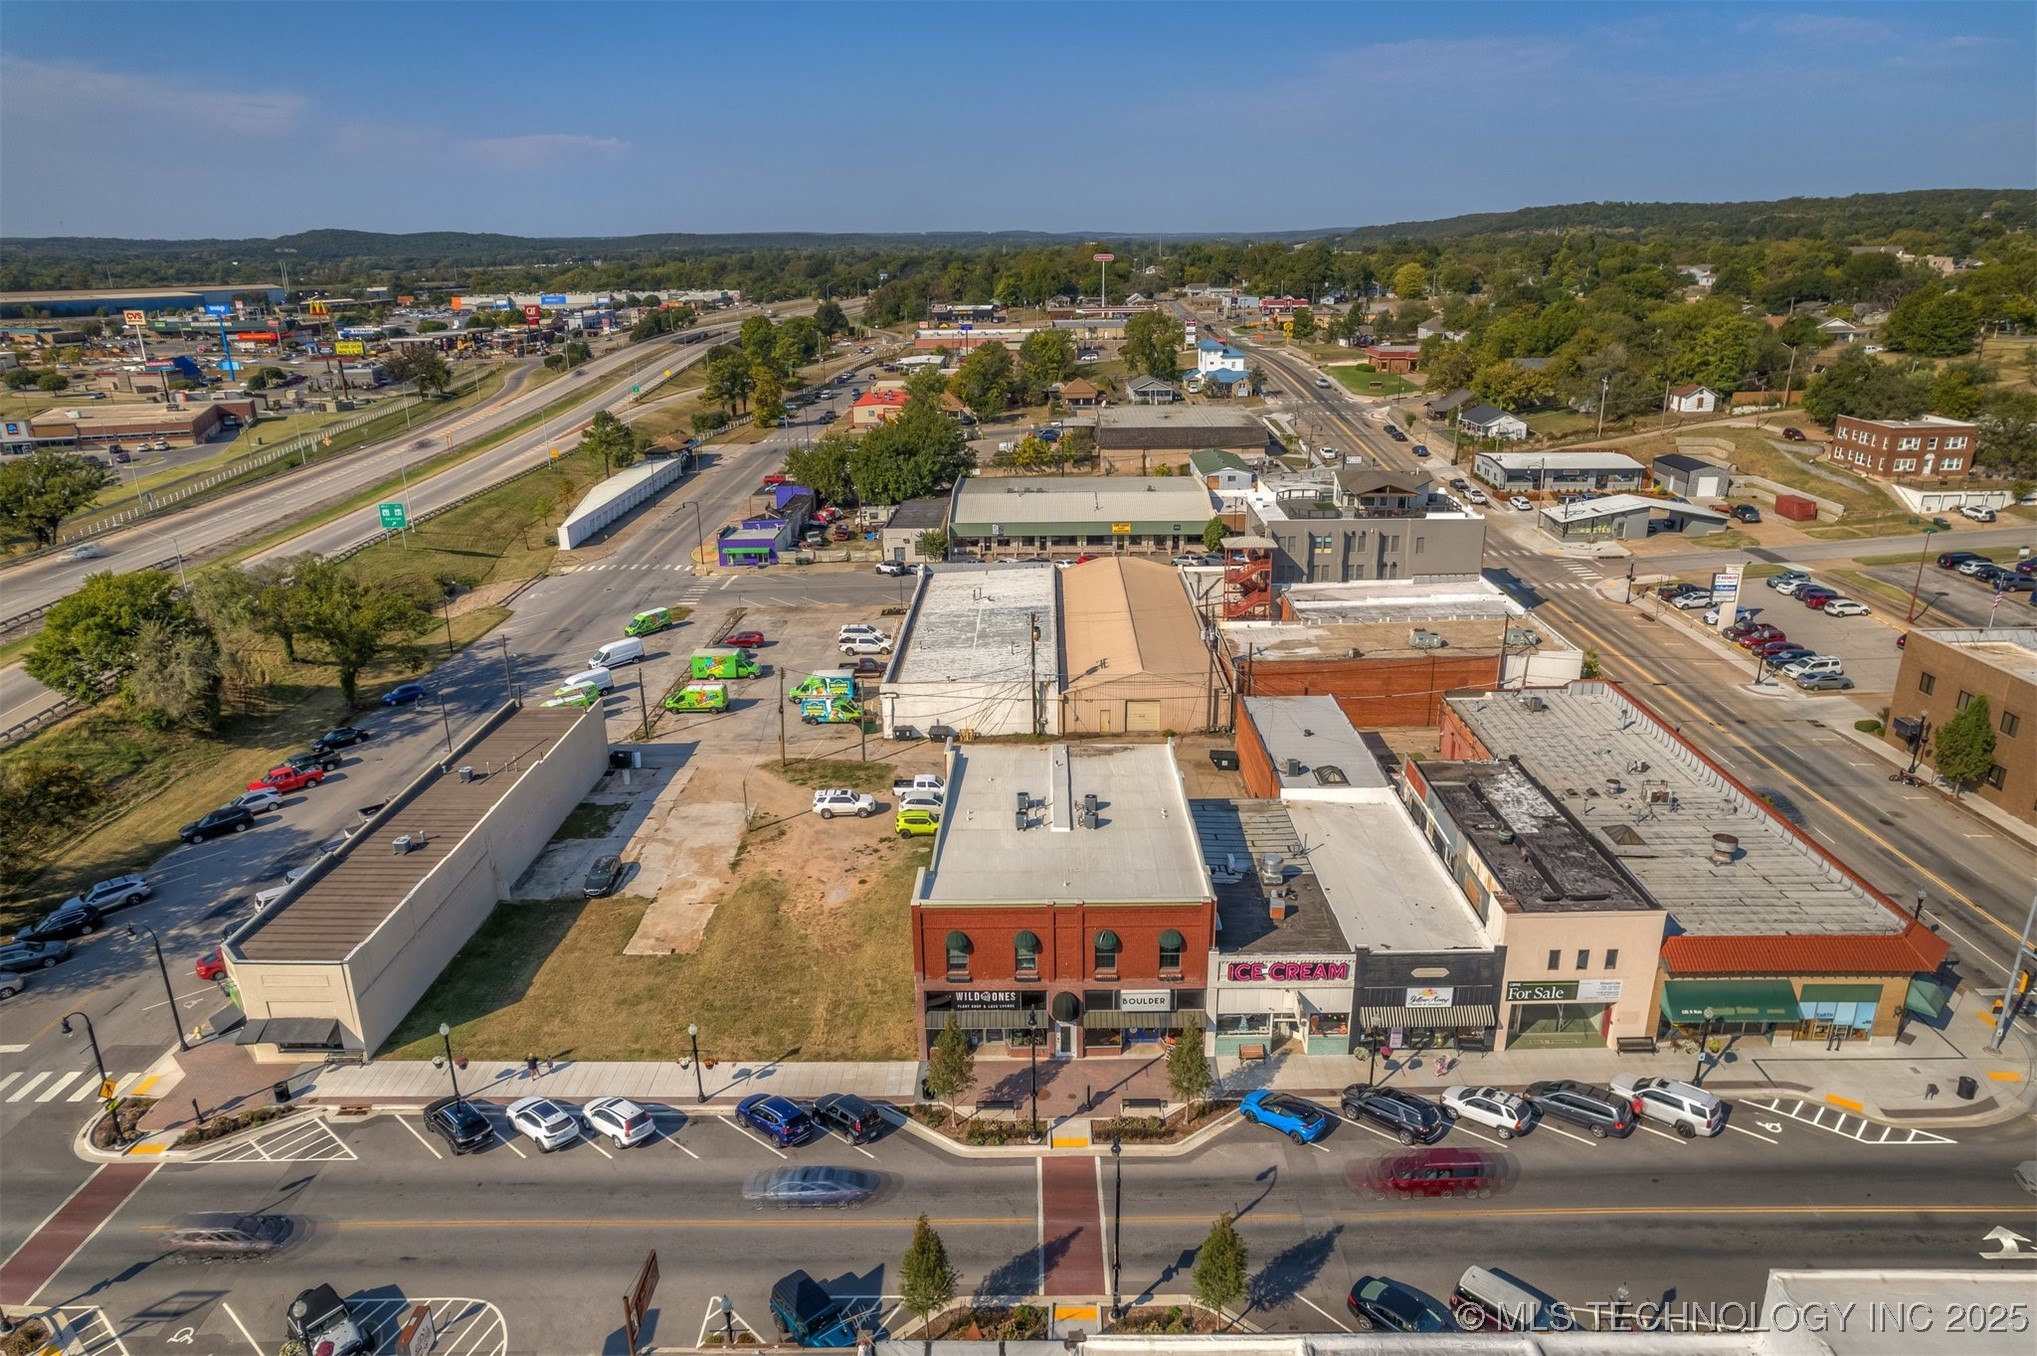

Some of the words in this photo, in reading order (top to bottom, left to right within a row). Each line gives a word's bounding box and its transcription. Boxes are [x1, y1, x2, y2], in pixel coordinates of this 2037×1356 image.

[526, 307, 536, 315] QT
[126, 312, 143, 320] CVS
[1227, 962, 1263, 982] ICE
[1268, 962, 1348, 981] CREAM
[955, 991, 980, 1001] WILD
[991, 991, 1016, 1001] ONES
[1508, 987, 1532, 1000] For
[1533, 986, 1564, 999] Sale
[1122, 997, 1166, 1005] BOULDER
